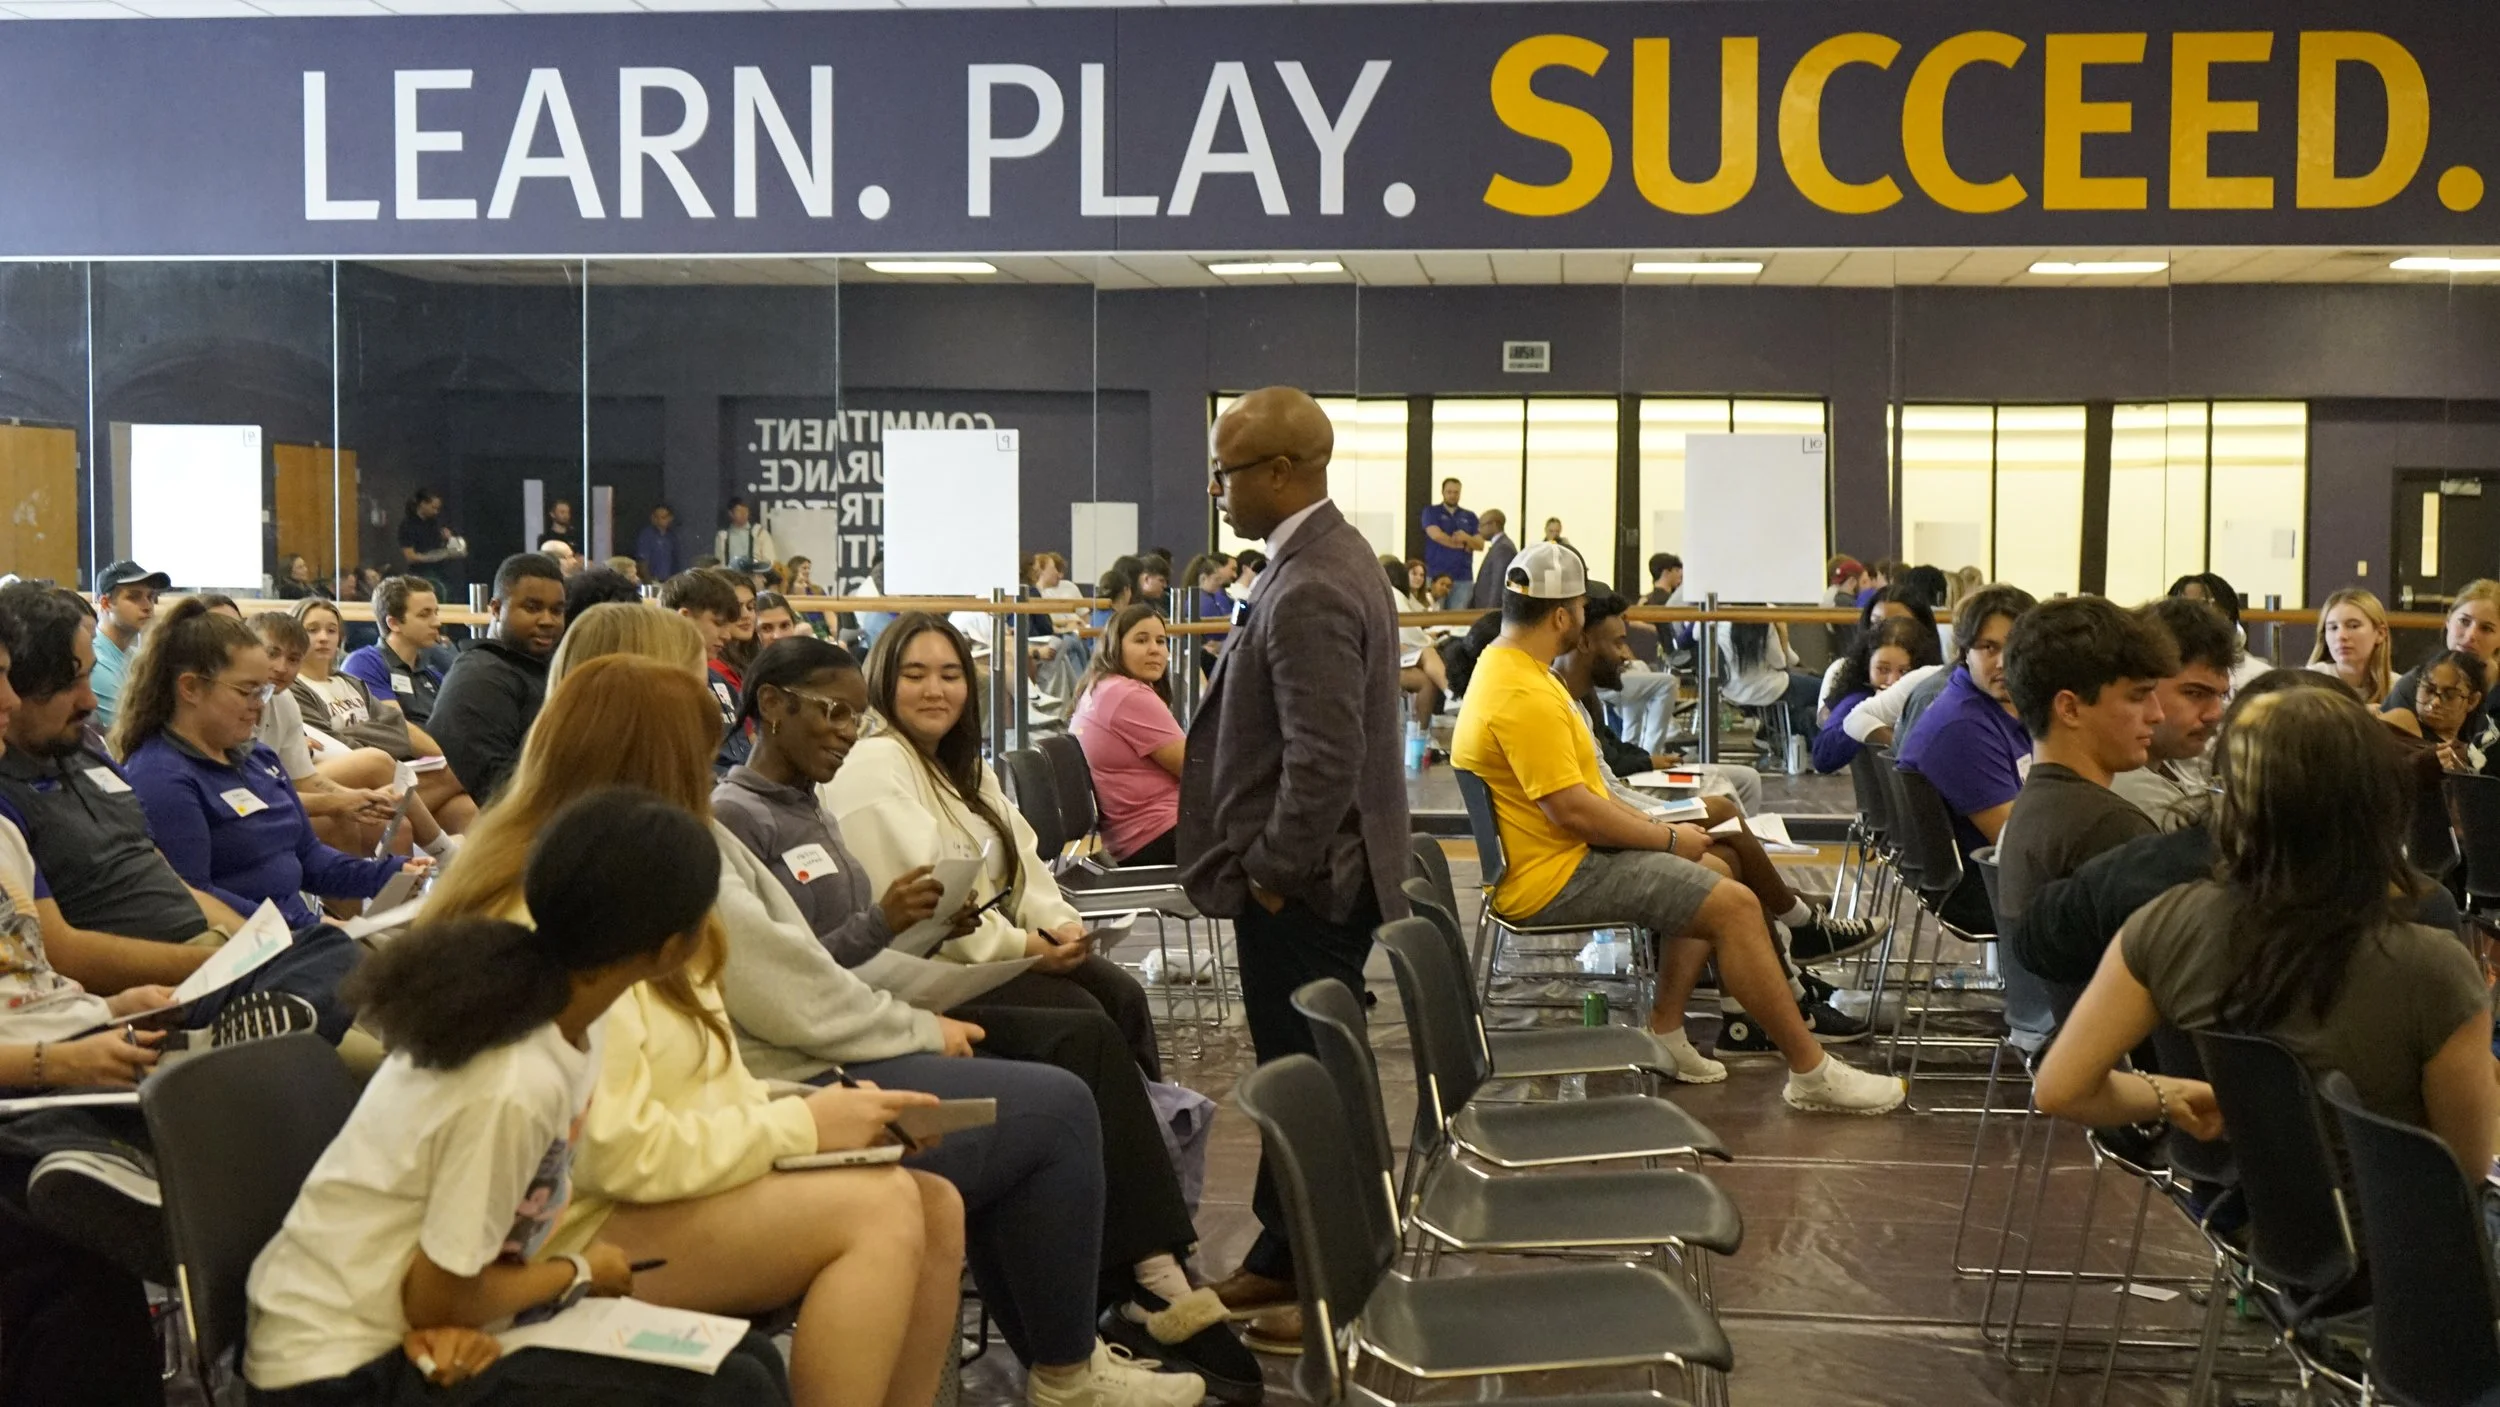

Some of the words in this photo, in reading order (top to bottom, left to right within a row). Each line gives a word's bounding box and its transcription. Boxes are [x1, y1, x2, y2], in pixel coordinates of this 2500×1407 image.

[304, 65, 891, 221] LEARN.
[968, 60, 1416, 218] PLAY.
[1483, 30, 2485, 217] SUCCEED.
[1001, 434, 1011, 449] 9
[1810, 437, 1823, 449] 10
